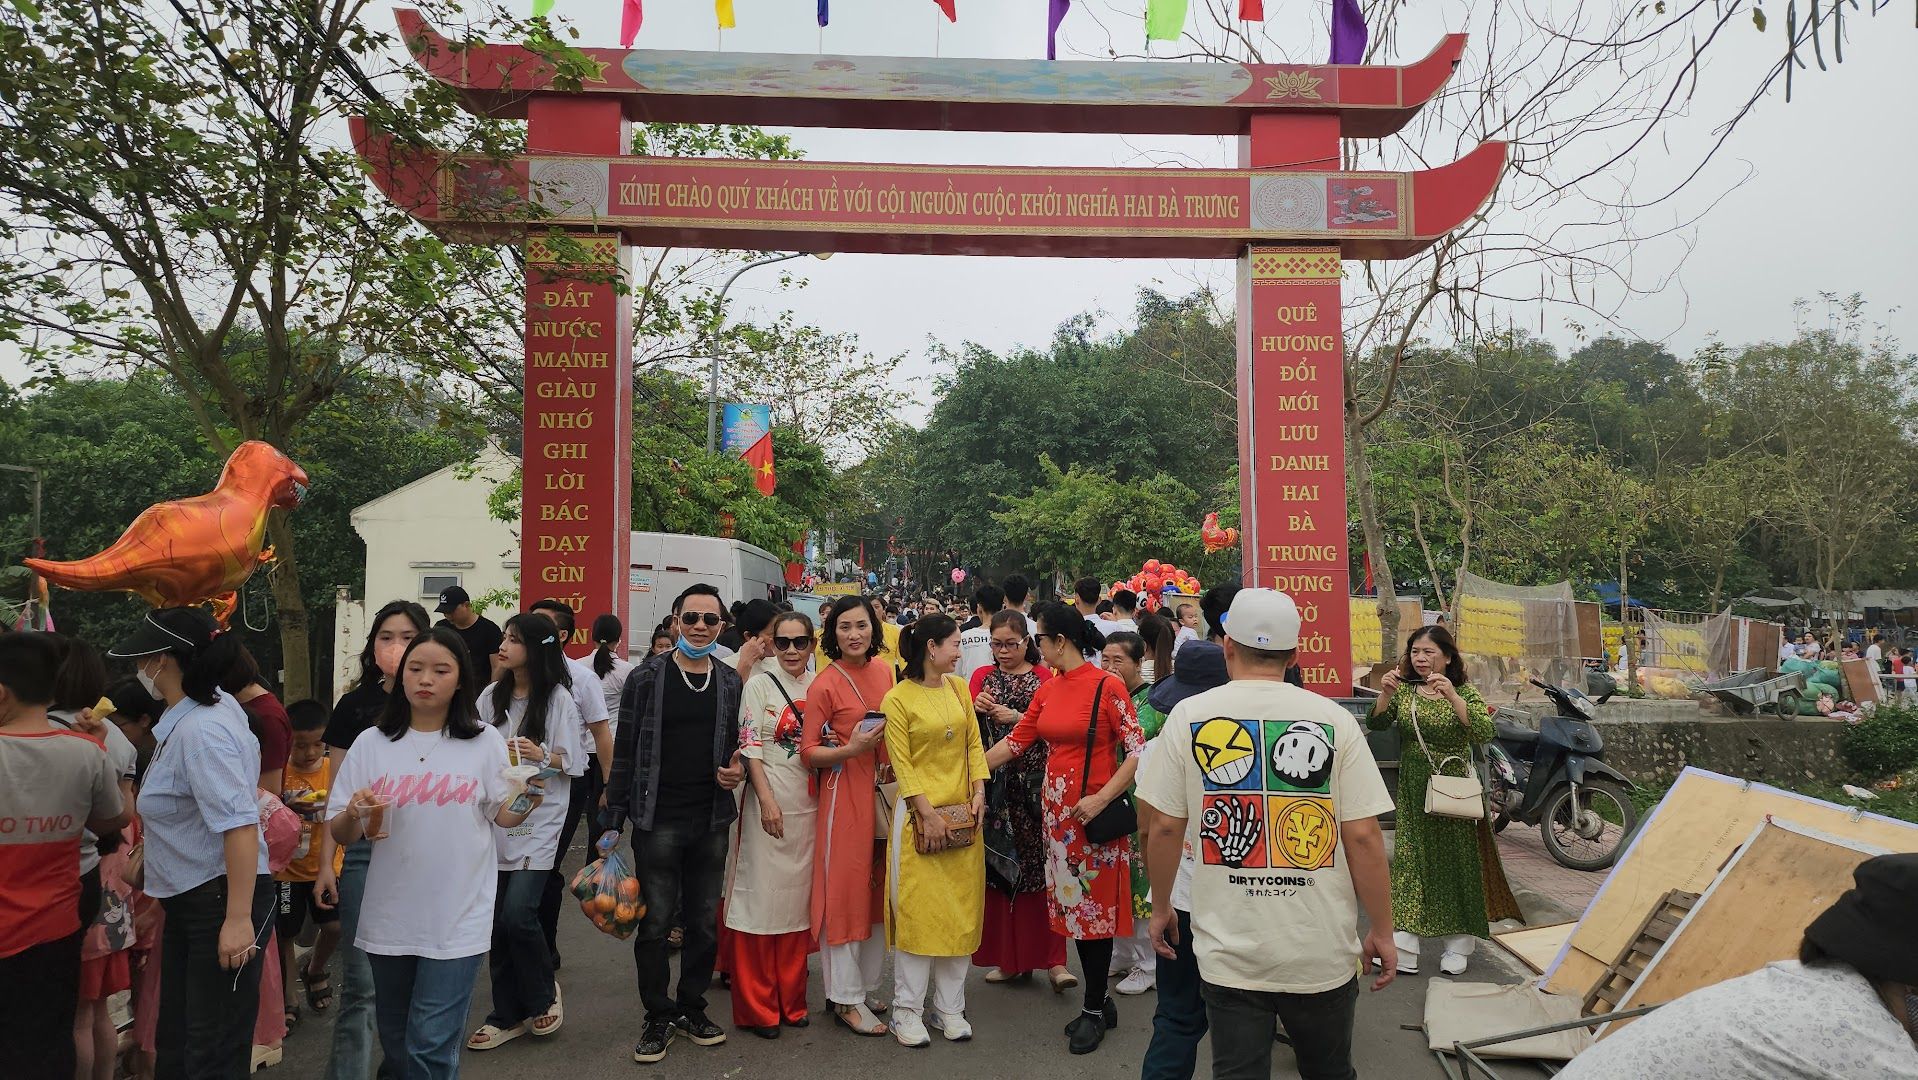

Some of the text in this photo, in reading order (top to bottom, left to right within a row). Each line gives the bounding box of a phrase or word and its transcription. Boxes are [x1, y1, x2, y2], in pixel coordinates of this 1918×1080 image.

[619, 174, 1239, 222] KÍNH CHÀO QUÝ KHÁCH VỀ VỚI CỘI NGUỒN CUỘC KHỞI NGHĨA HAI BÀ TRƯNG
[543, 283, 593, 308] ĐẤT
[1277, 302, 1318, 325] QUÊ
[533, 317, 601, 338] NƯỚC
[1261, 335, 1334, 352] HƯƠNG
[533, 352, 608, 372] MẠNH
[1280, 357, 1317, 382] ĐỔI
[537, 377, 597, 399] GIÀU
[1279, 390, 1319, 411] MỚI
[539, 408, 593, 429] NHỚ
[1280, 425, 1318, 441] LƯU
[543, 443, 588, 459] GHI
[1271, 455, 1329, 471] DANH
[545, 468, 585, 490] LỜI
[1282, 485, 1319, 501] HAI
[540, 499, 589, 521] BÁC
[1288, 510, 1316, 531] BÀ
[538, 535, 590, 556] DẠY
[1268, 545, 1337, 562] TRƯNG
[542, 561, 585, 583] GÌN
[1274, 575, 1333, 596] DỰNG
[1297, 631, 1331, 653] HỞI
[1301, 662, 1341, 684] HĨA
[25, 814, 72, 833] TWO
